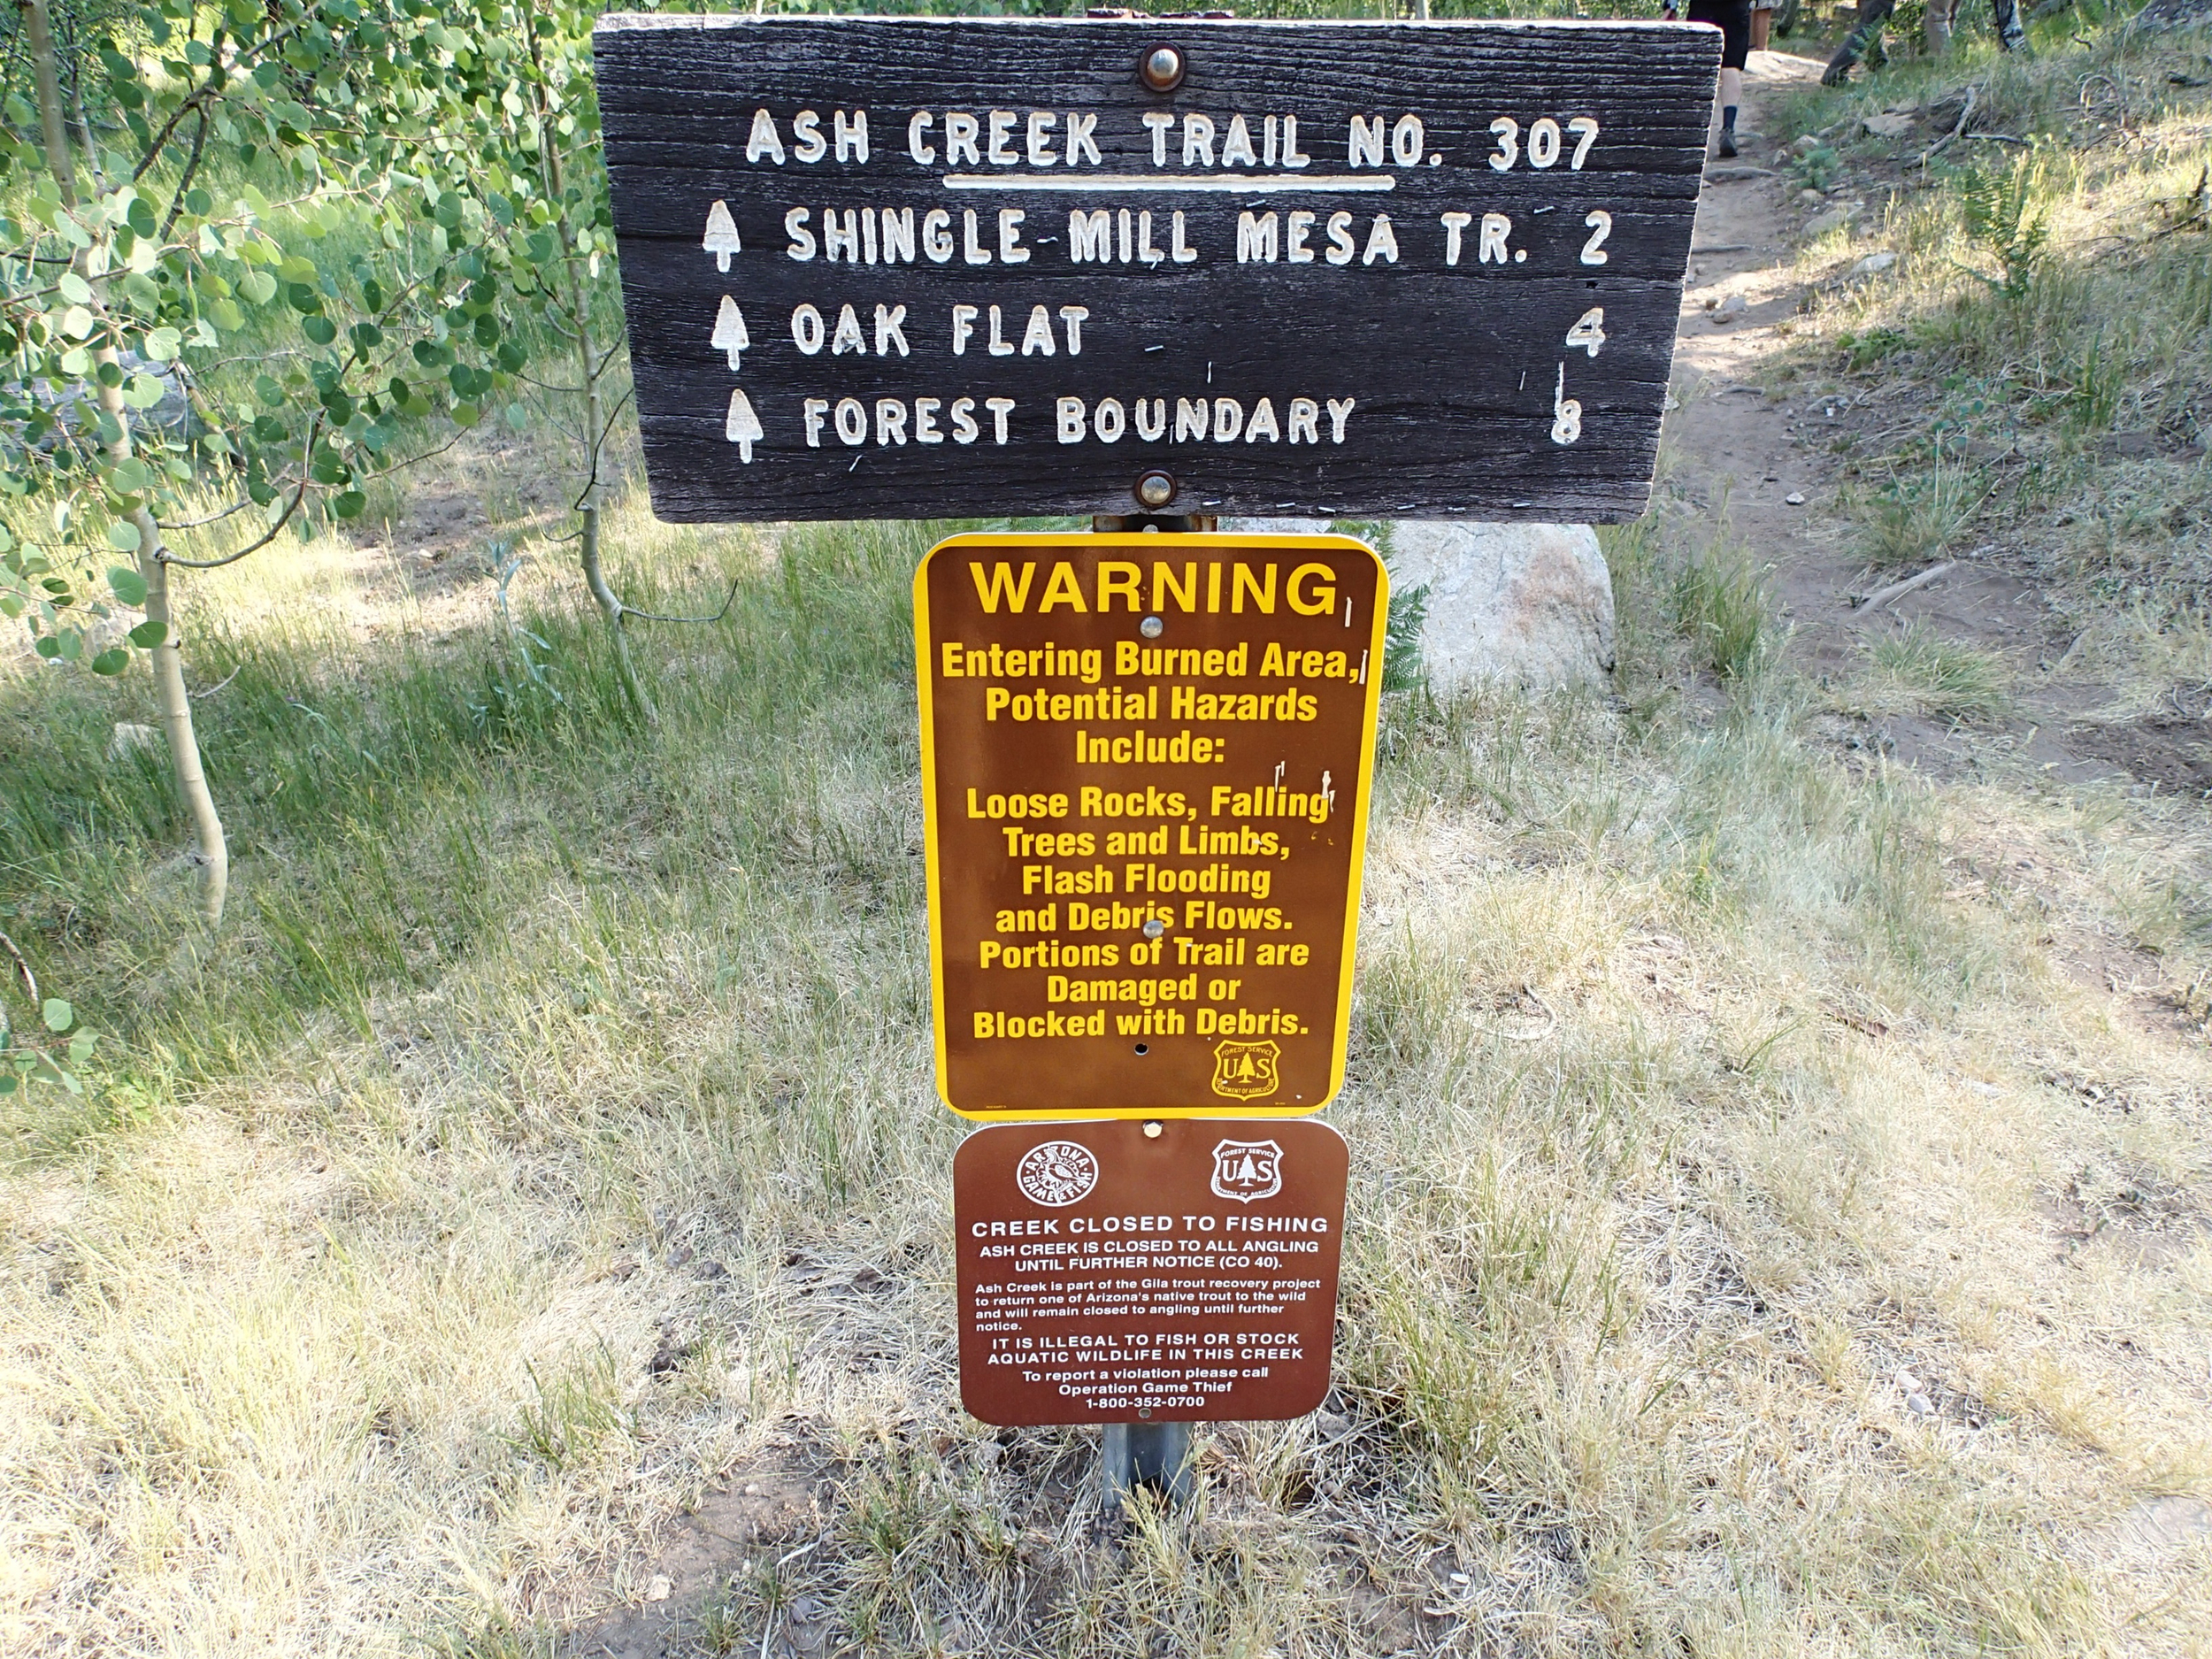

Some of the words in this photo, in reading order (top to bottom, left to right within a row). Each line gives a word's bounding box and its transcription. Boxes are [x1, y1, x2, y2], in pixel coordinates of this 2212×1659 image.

[746, 109, 869, 165] ASH
[909, 110, 1102, 166] CREEK
[1142, 112, 1310, 167] TRAIL
[1348, 114, 1441, 167] NO.
[1489, 118, 1599, 172] 307
[785, 207, 1030, 265] SHINGLE
[1068, 209, 1197, 268] MILL
[1237, 211, 1398, 265] MESA
[1440, 212, 1526, 265] TR.
[1580, 211, 1612, 265] 2
[787, 303, 910, 357] OAK
[953, 305, 1089, 356] FLAT
[1566, 308, 1606, 357] 4
[804, 398, 1015, 447] FOREST
[1056, 396, 1355, 443] BOUNDARY
[1551, 395, 1582, 445] 8
[970, 562, 1335, 615] WARNING
[942, 642, 1101, 683] Entering
[1116, 641, 1248, 676] Burned
[1260, 643, 1358, 683] Area,
[987, 687, 1156, 721] Potential
[1171, 687, 1317, 721] Hazards
[1077, 730, 1225, 763] Include:
[968, 788, 1068, 818] Loose
[1081, 787, 1196, 821] Rocks,
[1211, 784, 1329, 823] Falling
[1002, 827, 1095, 856] Trees
[1106, 826, 1168, 856] and
[1180, 826, 1289, 860] Limbs,
[1024, 864, 1113, 894] Flash
[1126, 864, 1271, 899] Flooding
[996, 903, 1056, 933] and
[1069, 901, 1174, 933] Debris
[1186, 901, 1292, 930] Flows.
[980, 940, 1118, 968] Portions
[1131, 935, 1163, 965] of
[1173, 937, 1245, 965] Trail
[1256, 944, 1309, 965] are
[1048, 973, 1197, 1006] Damaged
[1209, 979, 1240, 1000] or
[974, 1010, 1104, 1038] Blocked
[1116, 1009, 1185, 1035] with
[1197, 1009, 1308, 1034] Debris.
[1221, 1047, 1245, 1057] FOREST
[1248, 1046, 1272, 1057] SERVICE
[1025, 1145, 1090, 1171] ARZONA
[1221, 1148, 1246, 1159] FOREST
[1248, 1148, 1274, 1159] SERVICE
[1023, 1175, 1054, 1202] GAME
[972, 1219, 1059, 1237] CREEK
[1070, 1216, 1172, 1233] CLOSED
[1183, 1216, 1215, 1231] TO
[1226, 1217, 1327, 1233] FISHING
[980, 1245, 1014, 1257] ASH
[1020, 1242, 1078, 1256] CREEK
[1084, 1241, 1098, 1253] IS
[1104, 1240, 1172, 1252] CLOSED
[1178, 1240, 1201, 1251] TO
[1205, 1240, 1238, 1251] ALL
[1242, 1240, 1318, 1252] ANGLING
[1016, 1259, 1064, 1271] UNTIL
[1070, 1256, 1148, 1270] FURTHER
[1153, 1256, 1215, 1267] NOTICE
[1220, 1256, 1249, 1270] (CO
[1255, 1256, 1282, 1270] 40).
[976, 1284, 1002, 1294] Ash
[1007, 1282, 1047, 1292] Creek
[1051, 1281, 1063, 1290] is
[1067, 1281, 1094, 1292] part
[1098, 1279, 1111, 1289] of
[1116, 1279, 1137, 1288] the
[1141, 1279, 1168, 1288] Gila
[1210, 1280, 1268, 1290] recovery
[1273, 1279, 1320, 1290] project
[994, 1296, 1034, 1305] return
[1069, 1294, 1081, 1302] of
[1087, 1292, 1149, 1302] Arizona's
[1154, 1292, 1194, 1301] native
[1199, 1292, 1231, 1301] trout
[1235, 1292, 1248, 1301] to
[1253, 1292, 1274, 1301] the
[1279, 1292, 1305, 1301] wild
[976, 1310, 1001, 1318] and
[1005, 1308, 1027, 1317] will
[1033, 1307, 1079, 1317] remain
[1083, 1305, 1127, 1315] closed
[1133, 1305, 1145, 1314] to
[1150, 1304, 1199, 1316] angling
[1204, 1304, 1233, 1313] until
[1239, 1304, 1284, 1313] further
[977, 1322, 1022, 1331] notice.
[993, 1339, 1009, 1349] IT
[1017, 1338, 1033, 1348] IS
[1041, 1335, 1118, 1348] ILLEGAL
[1125, 1334, 1148, 1345] TO
[1156, 1334, 1196, 1345] FISH
[1204, 1333, 1229, 1344] OR
[1237, 1333, 1299, 1344] STOCK
[988, 1352, 1068, 1364] AQUATIC
[1076, 1349, 1162, 1362] WILDLIFE
[1170, 1349, 1186, 1359] IN
[1194, 1348, 1233, 1359] THIS
[1241, 1348, 1302, 1359] CREEK
[1023, 1371, 1041, 1381] To
[1046, 1370, 1095, 1383] report
[1113, 1368, 1180, 1379] violation
[1186, 1367, 1238, 1379] please
[1242, 1367, 1268, 1377] call
[1059, 1383, 1137, 1397] Operation
[1142, 1382, 1188, 1393] Game
[1193, 1382, 1232, 1392] Thief
[1086, 1396, 1204, 1409] 1-800-352-0700
